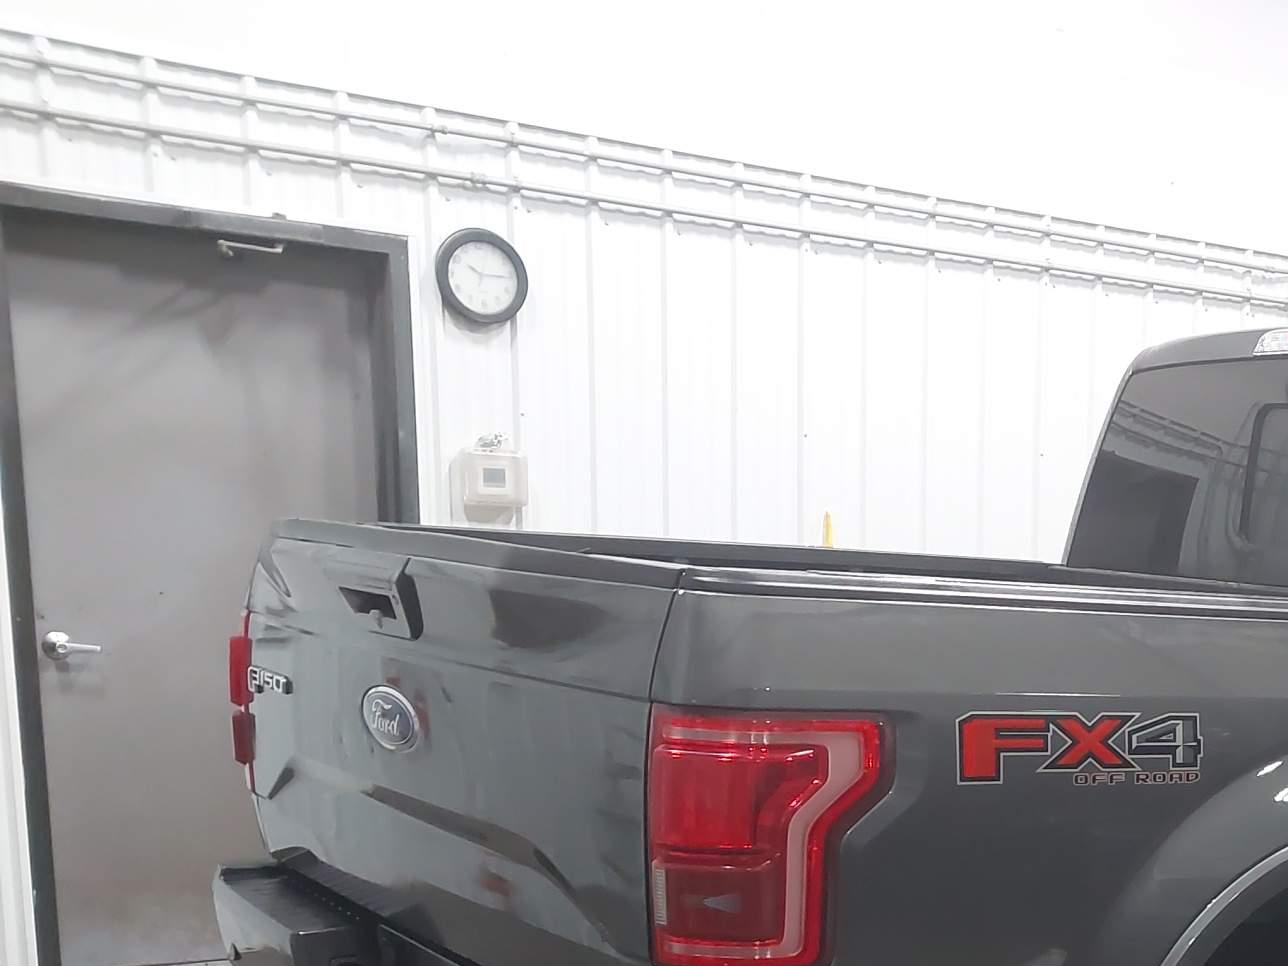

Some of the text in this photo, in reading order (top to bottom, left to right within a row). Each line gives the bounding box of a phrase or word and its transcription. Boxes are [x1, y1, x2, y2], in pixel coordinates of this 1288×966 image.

[955, 710, 1203, 785] FX4
[1072, 771, 1201, 786] OFF ROAD
